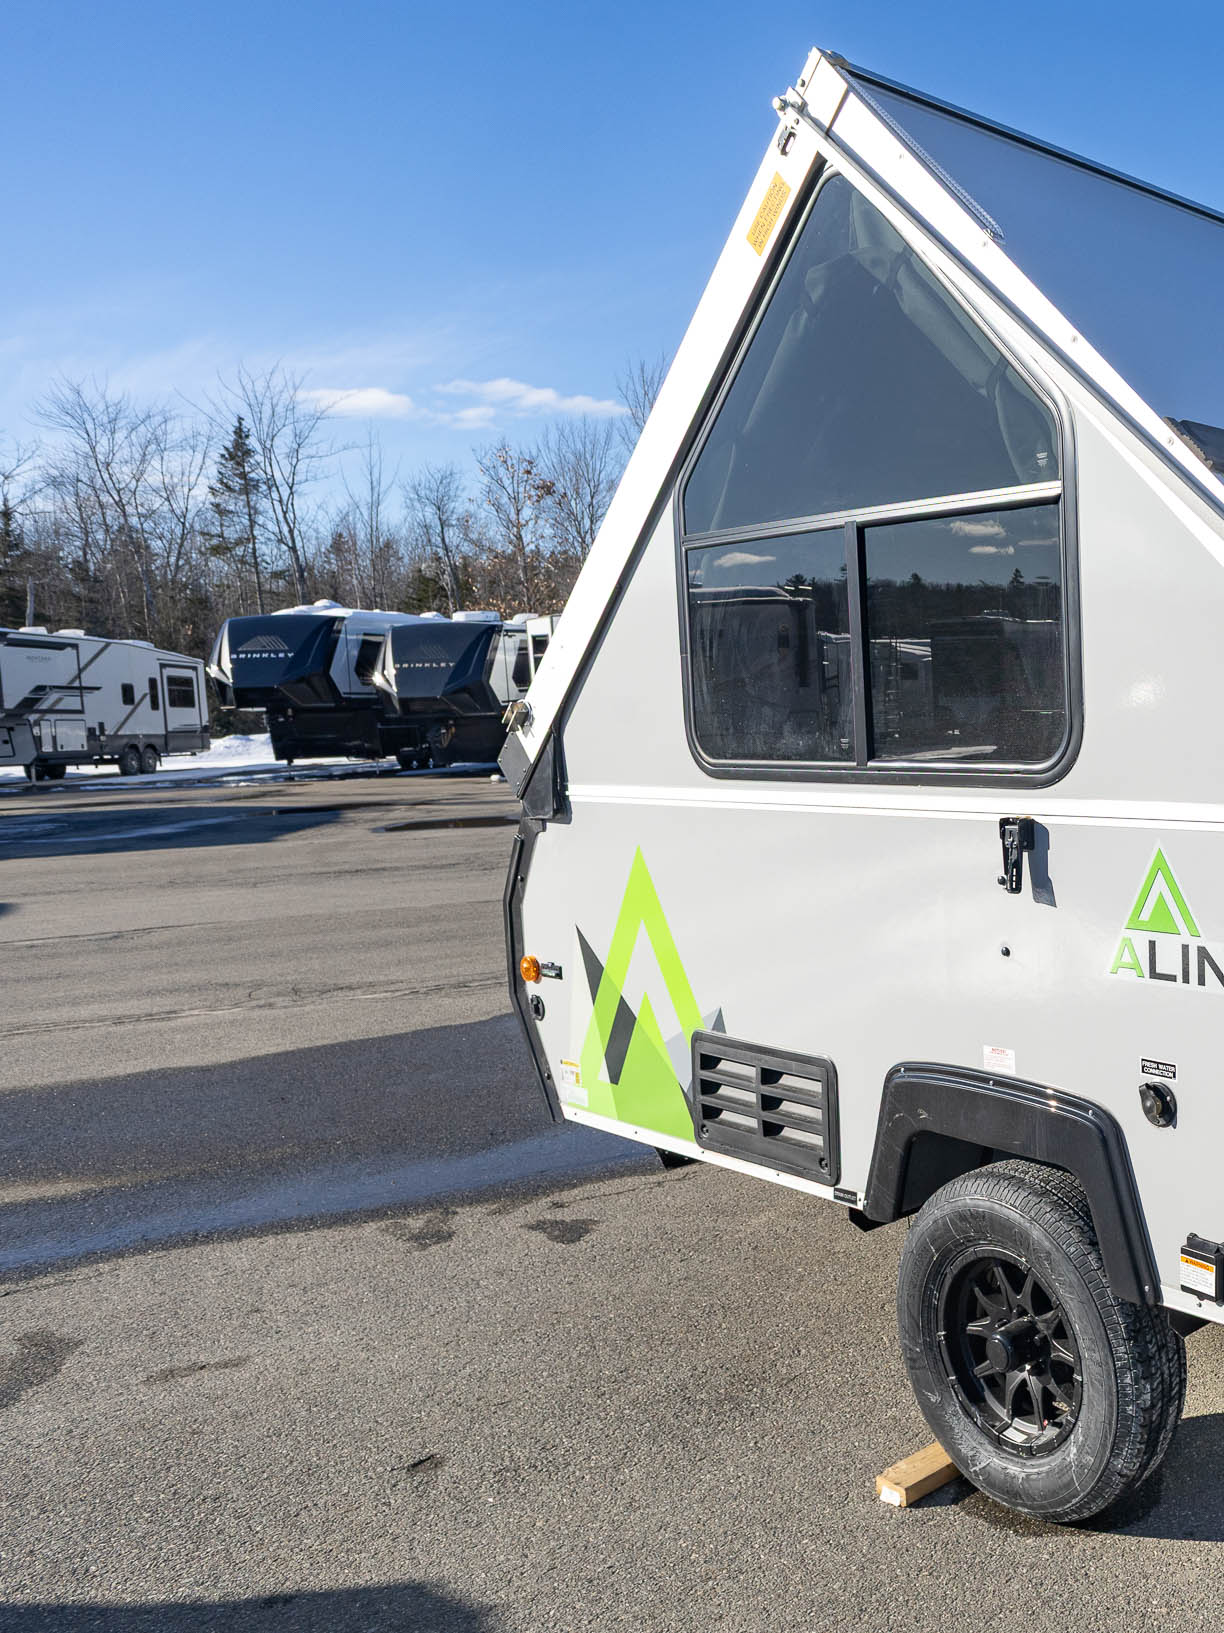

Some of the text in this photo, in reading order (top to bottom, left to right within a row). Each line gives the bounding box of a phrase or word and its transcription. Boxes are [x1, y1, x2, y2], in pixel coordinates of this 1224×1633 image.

[759, 182, 777, 218] CAUTION
[394, 661, 456, 669] BRINKLEY
[1142, 1060, 1176, 1073] FRESH WATER
[1143, 1066, 1174, 1078] CONNECTION
